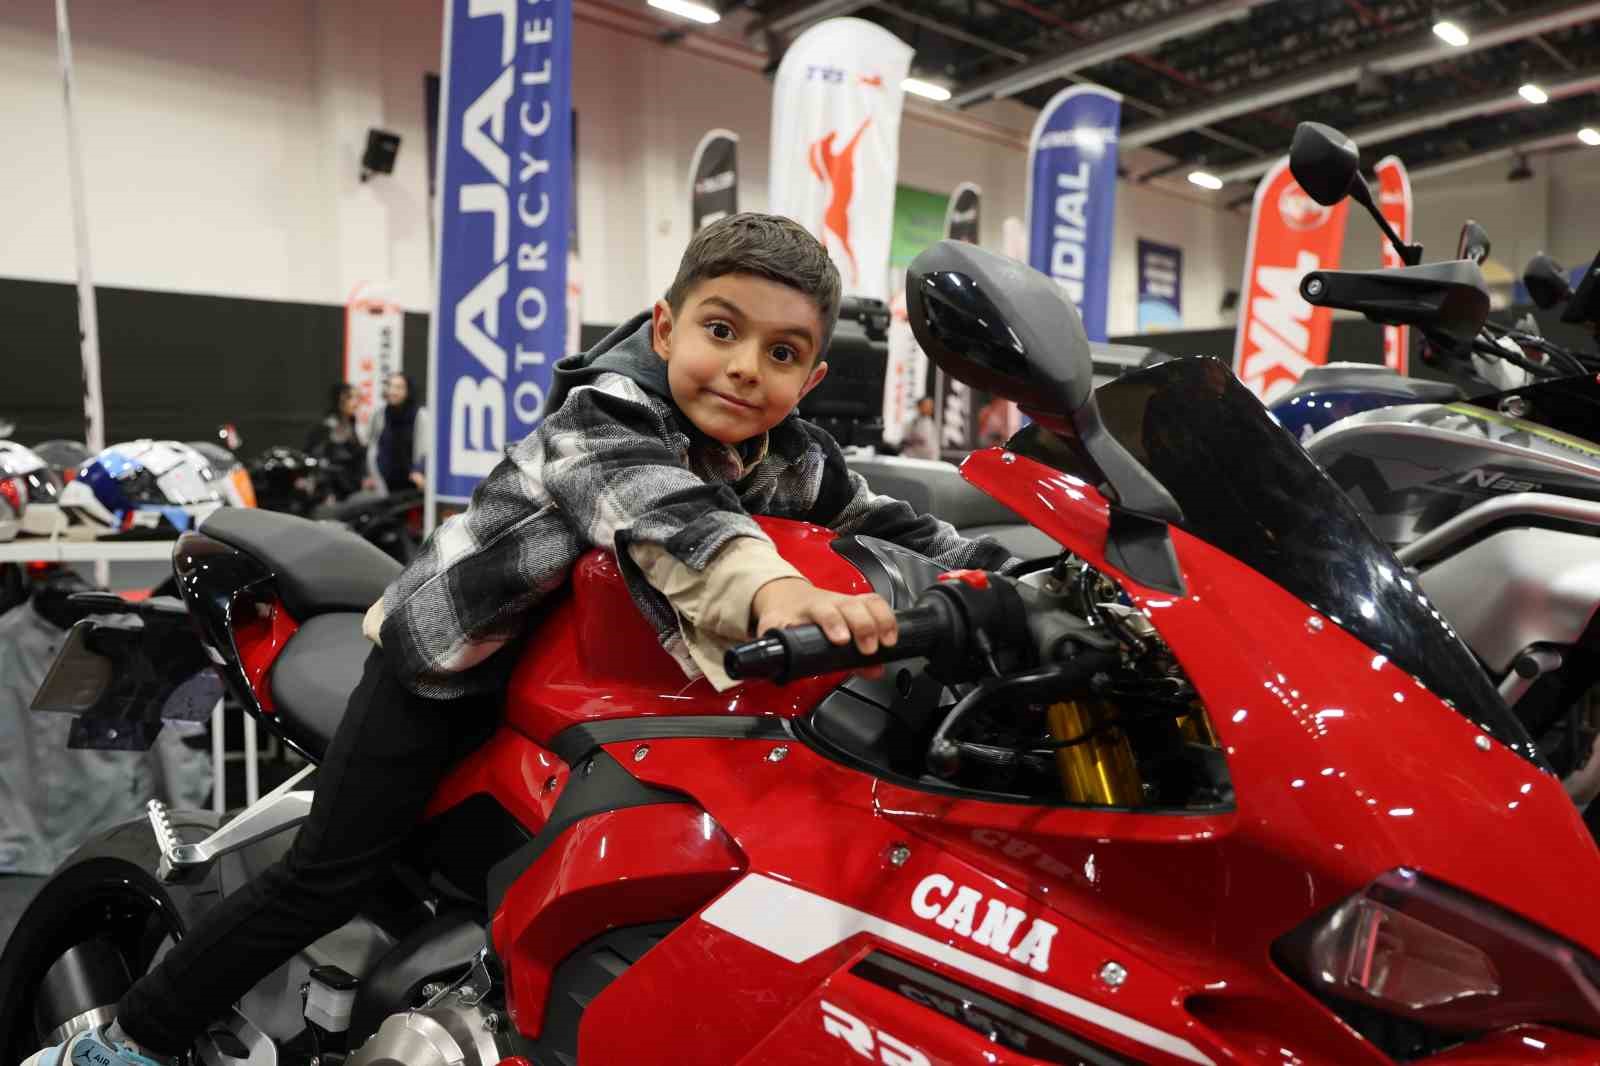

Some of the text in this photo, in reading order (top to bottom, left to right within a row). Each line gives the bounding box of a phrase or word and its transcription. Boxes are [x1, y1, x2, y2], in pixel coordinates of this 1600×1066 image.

[513, 0, 554, 424] OTORCYCLE
[909, 873, 1058, 973] CANA
[93, 1054, 110, 1066] AIR
